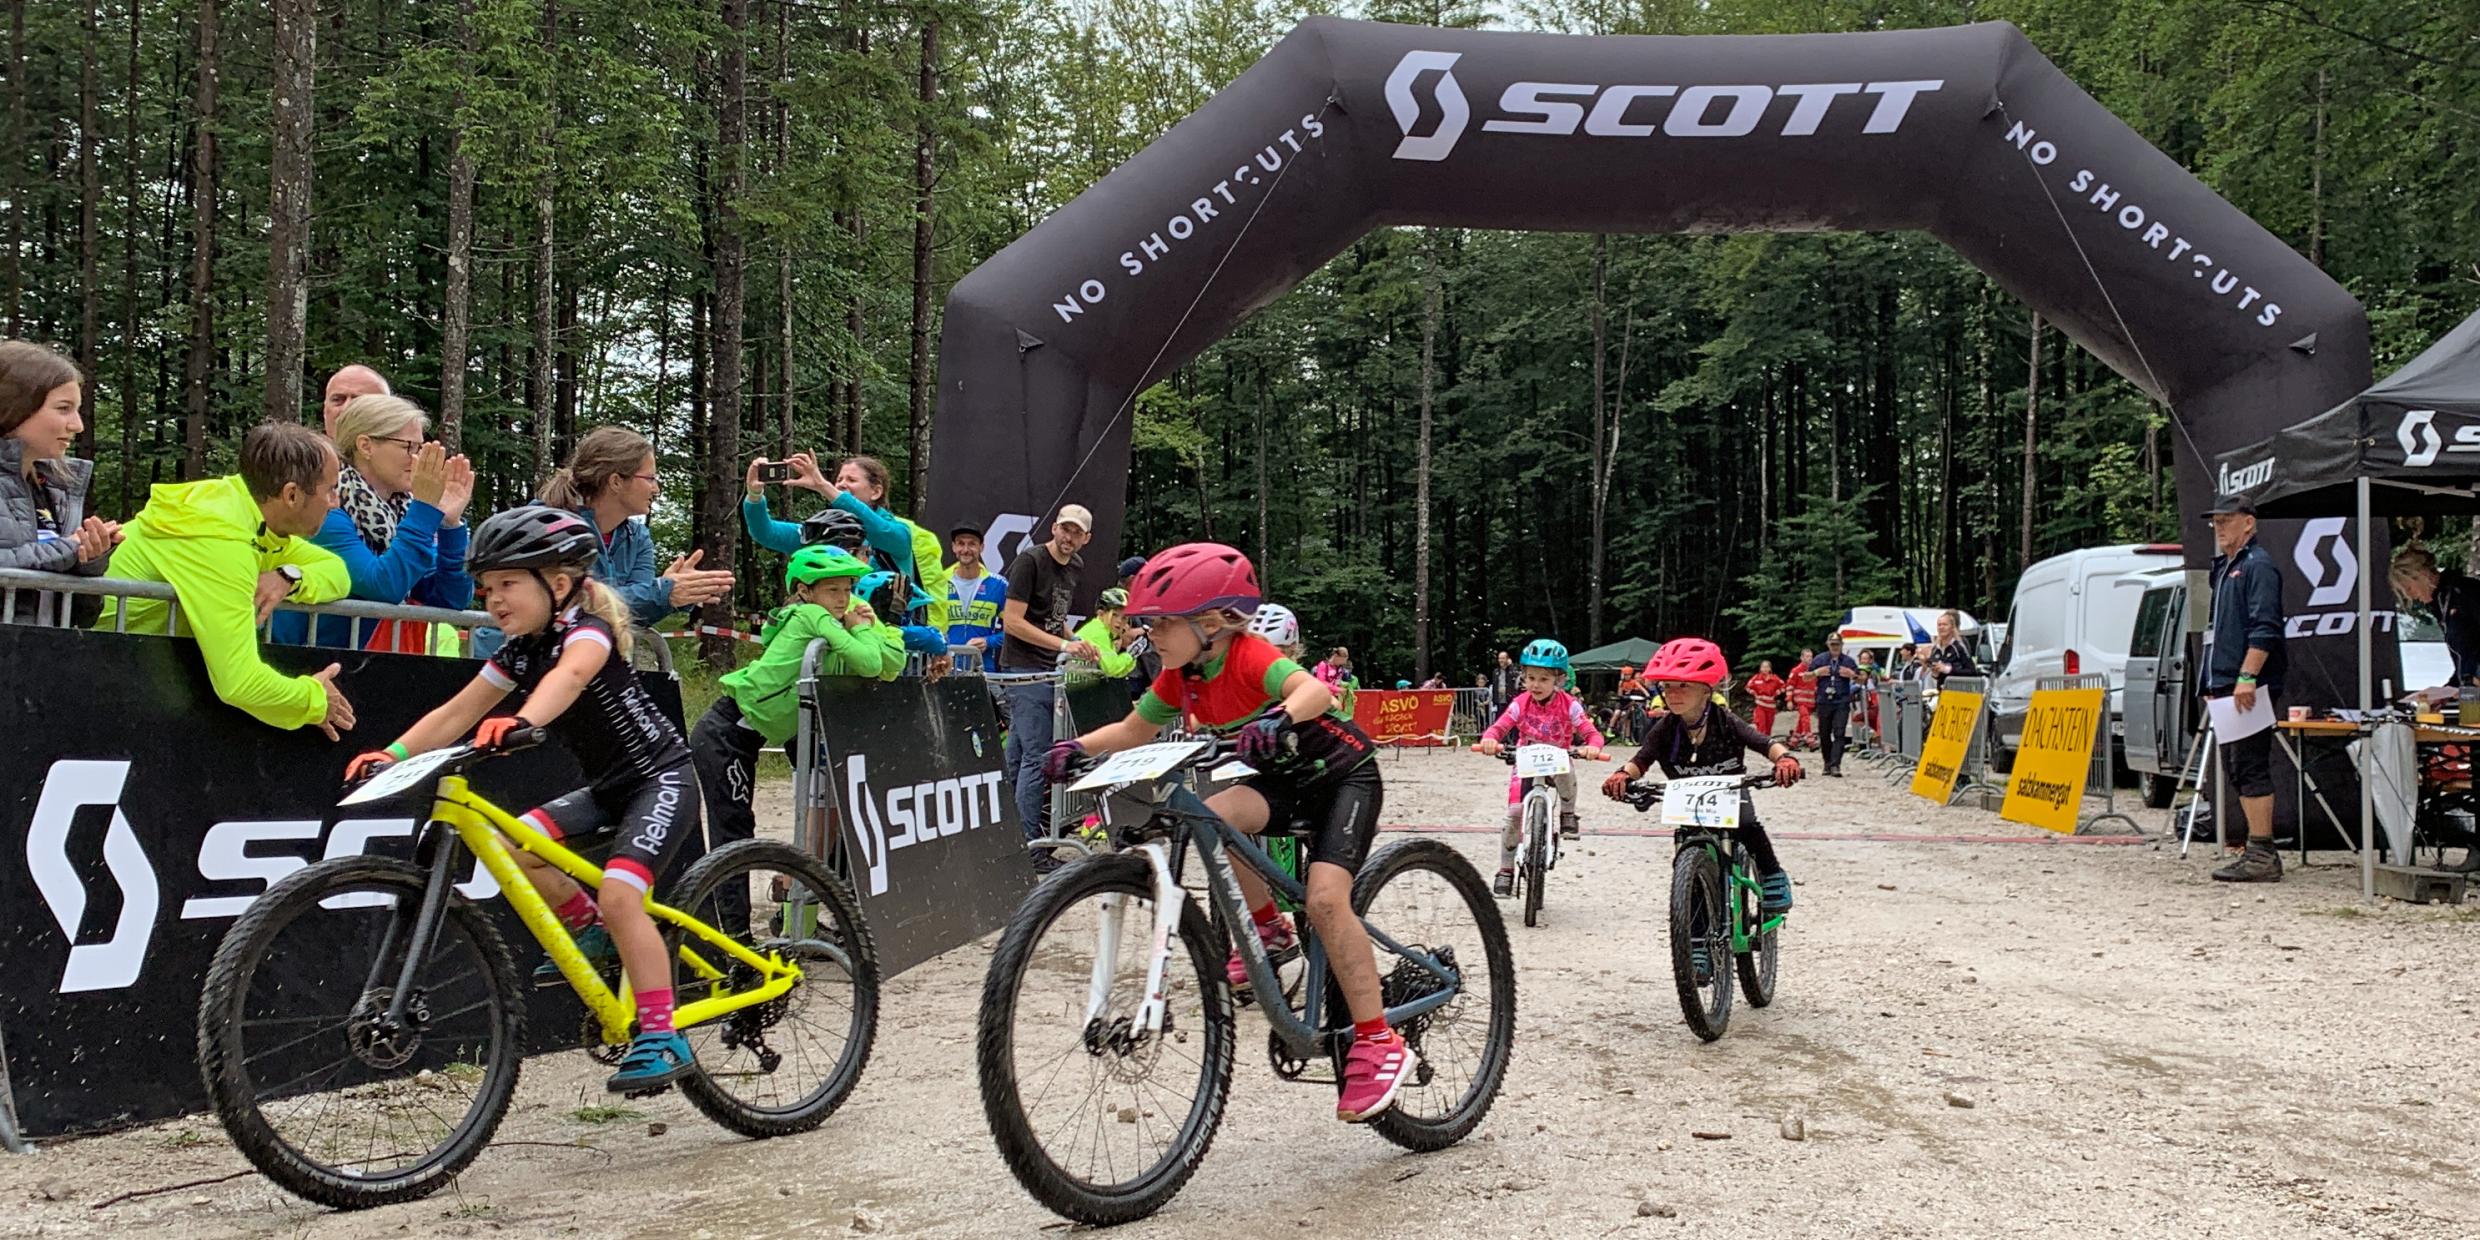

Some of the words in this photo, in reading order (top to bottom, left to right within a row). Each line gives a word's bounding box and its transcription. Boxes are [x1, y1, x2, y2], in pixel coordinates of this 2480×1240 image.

[1482, 79, 1943, 137] SCOTT
[1053, 278, 1107, 324] NO
[1119, 113, 1325, 276] SHORTCUTS
[2005, 120, 2057, 166] NO
[2069, 169, 2283, 328] SHORTCUTS
[2229, 456, 2276, 495] SCOTT
[2023, 706, 2096, 753] DACHSTEIN
[1115, 757, 1157, 770] 719
[1531, 754, 1554, 763] 712
[887, 771, 1004, 851] SCOTT
[1685, 793, 1718, 806] 714
[2016, 770, 2073, 811] salzkammergut
[1183, 1082, 1224, 1167] ROCKET
